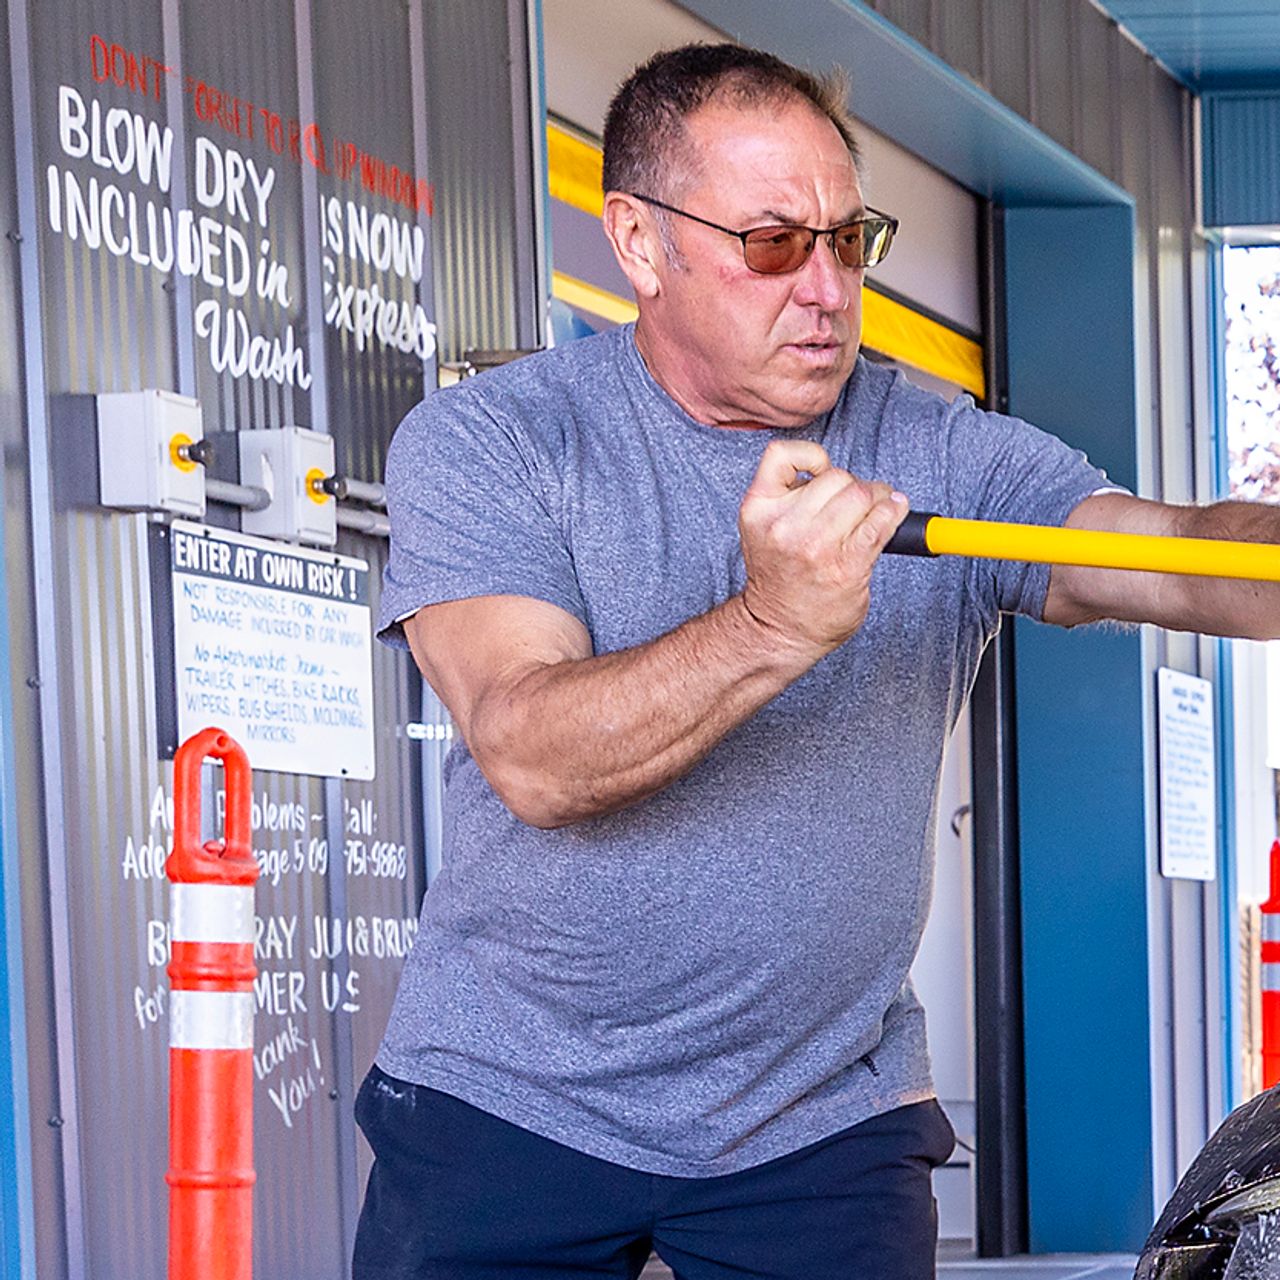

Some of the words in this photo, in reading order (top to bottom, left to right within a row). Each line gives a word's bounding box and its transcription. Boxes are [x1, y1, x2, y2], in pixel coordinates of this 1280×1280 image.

[59, 86, 174, 192] BLOW
[196, 137, 275, 228] DRY
[320, 189, 344, 255] IS
[347, 201, 425, 282] NOW
[48, 164, 250, 297] INCLUDED
[256, 239, 292, 308] in
[195, 300, 312, 391] Wash
[175, 534, 232, 576] ENTER
[235, 546, 257, 581] AT
[262, 553, 304, 589] OWN
[183, 580, 207, 600] NOT
[216, 586, 286, 615] RESPONSIBLE
[292, 601, 314, 618] FOR
[322, 606, 349, 625] ANY
[190, 604, 242, 630] DAMAGE
[194, 643, 210, 662] No
[185, 666, 236, 691] TRAILER
[292, 680, 317, 701] BIKE
[238, 697, 262, 720] BUG
